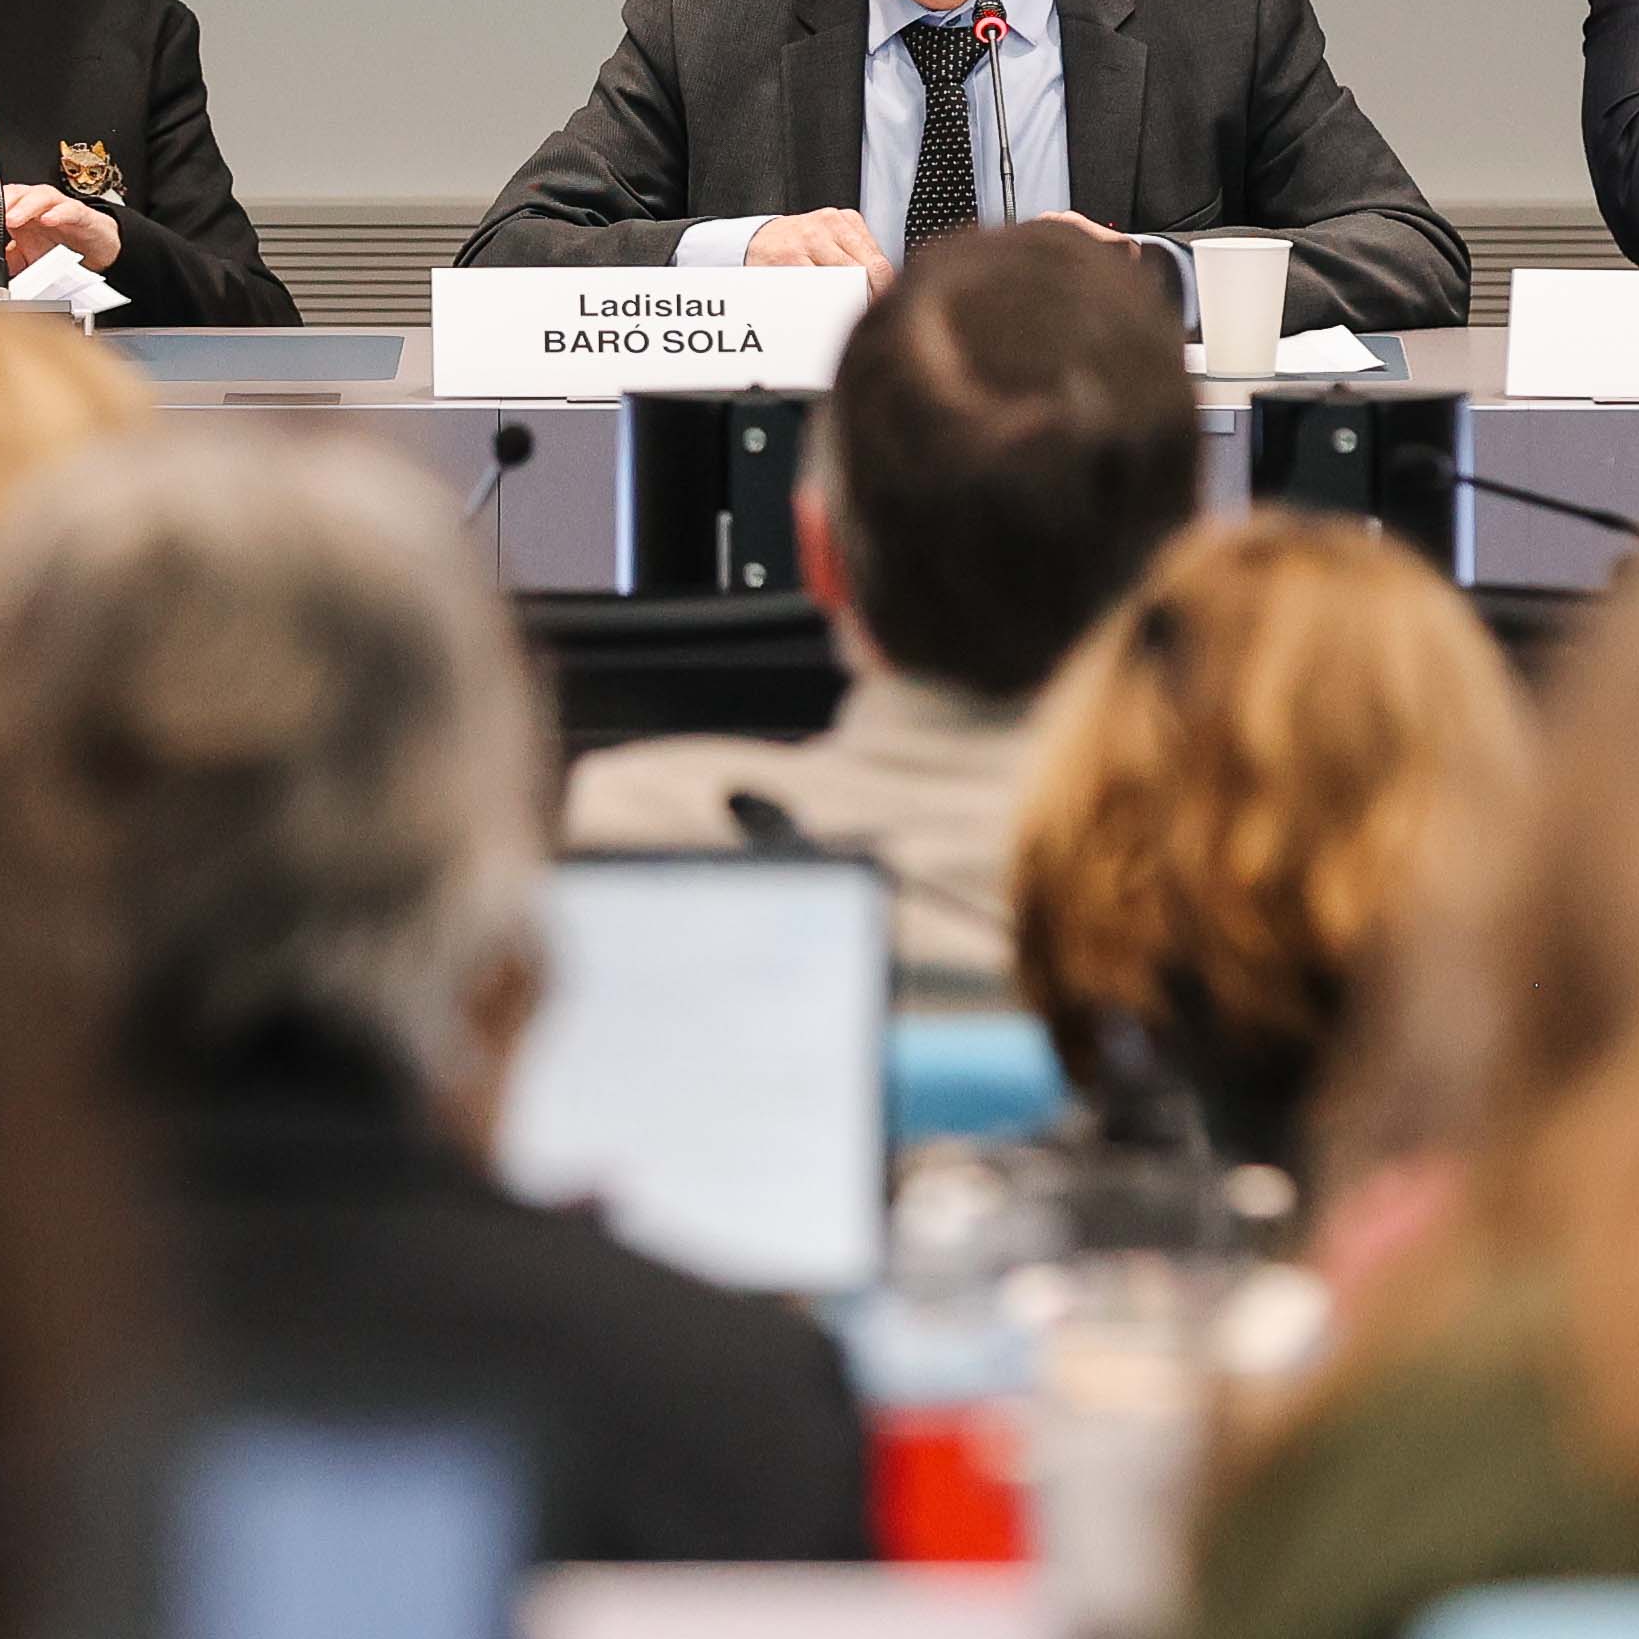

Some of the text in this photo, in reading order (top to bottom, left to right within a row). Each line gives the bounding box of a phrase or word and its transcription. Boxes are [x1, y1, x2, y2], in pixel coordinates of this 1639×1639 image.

[579, 293, 725, 318] Ladislau
[544, 323, 764, 354] BARÓ SOLÀ
